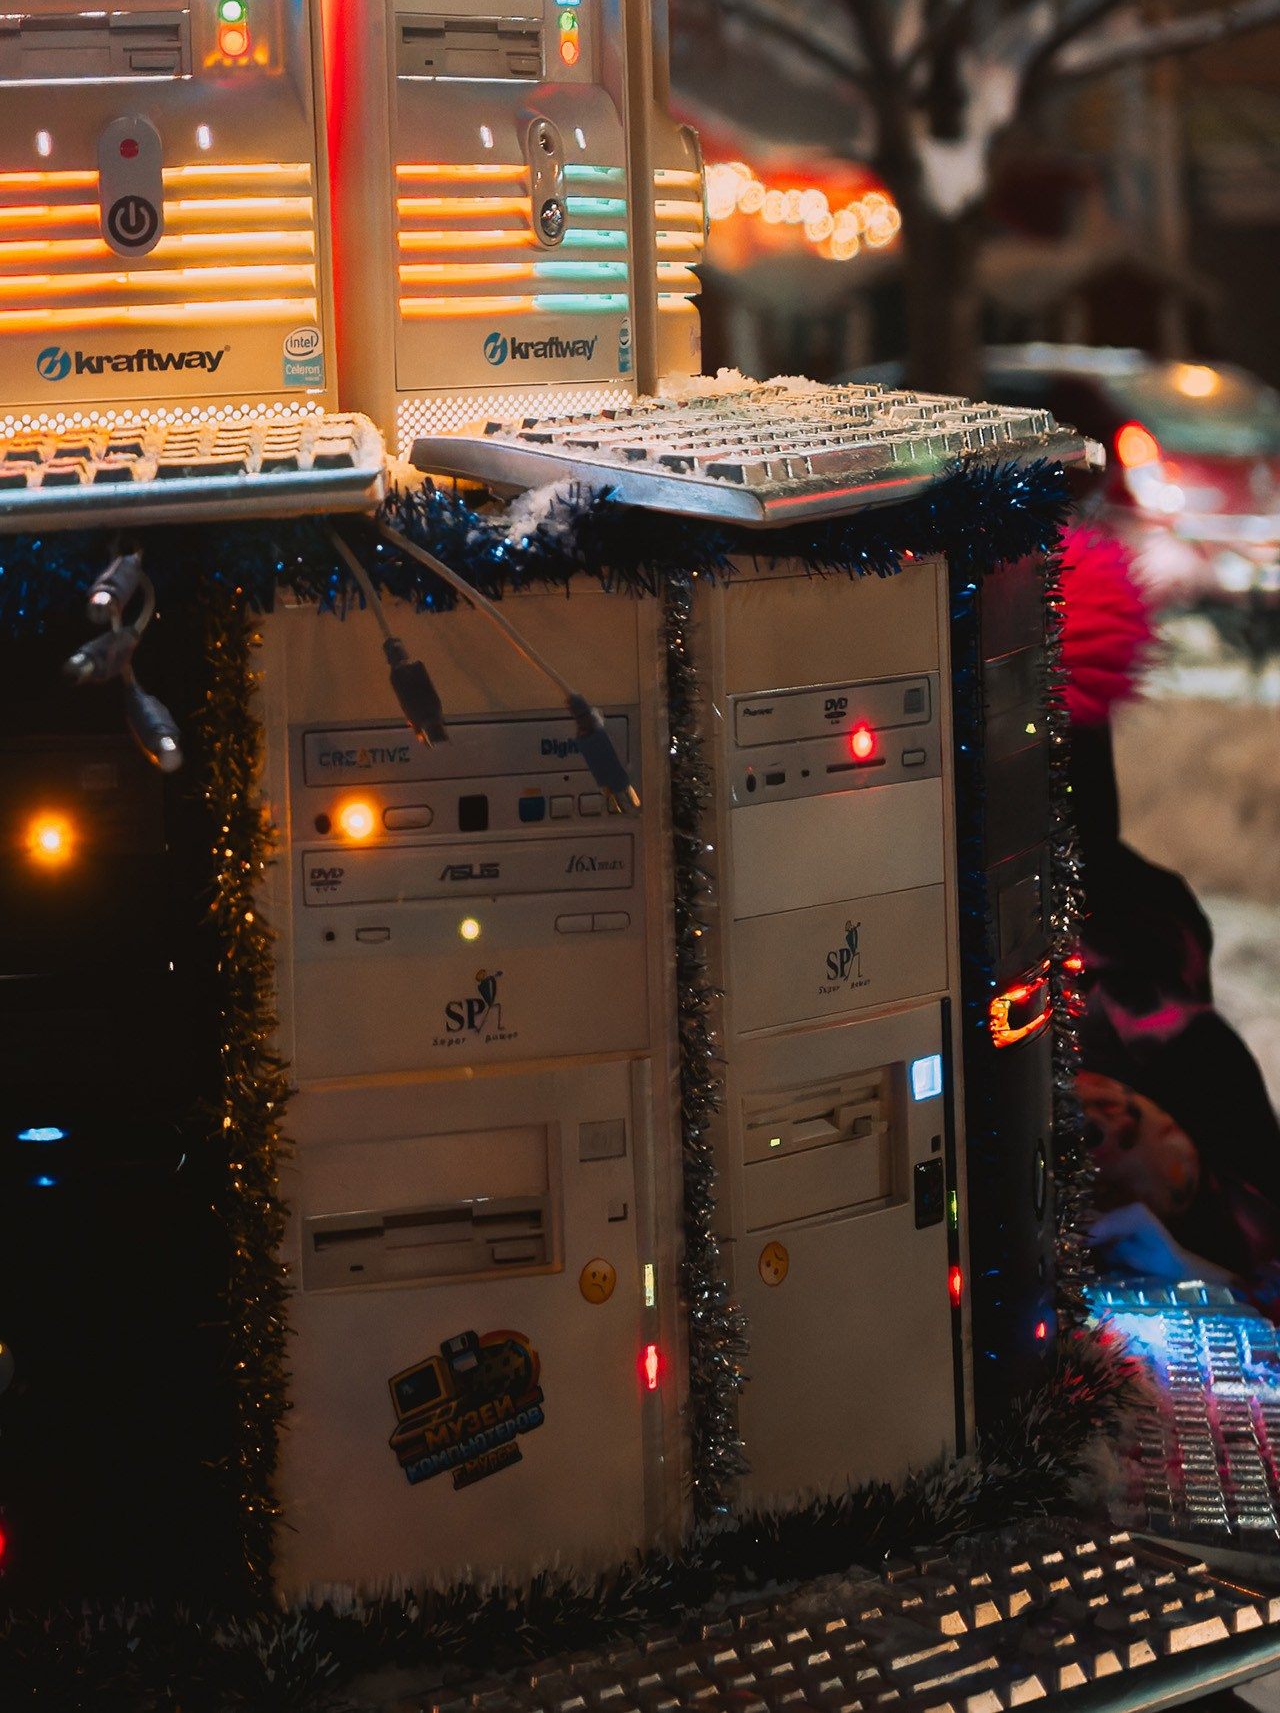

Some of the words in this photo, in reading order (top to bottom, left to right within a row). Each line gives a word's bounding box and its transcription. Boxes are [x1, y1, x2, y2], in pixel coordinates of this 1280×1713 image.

[289, 336, 315, 349] intel
[510, 335, 596, 361] kraftway
[74, 347, 225, 375] kraftway
[285, 363, 320, 375] Celeron
[825, 697, 849, 711] DVD
[319, 746, 411, 768] CREATIVE
[310, 867, 345, 879] DVD
[439, 862, 500, 882] ASUS
[826, 947, 852, 981] SP
[445, 998, 487, 1033] SP
[406, 1405, 542, 1483] КОМПЬЮТЕРОВ
